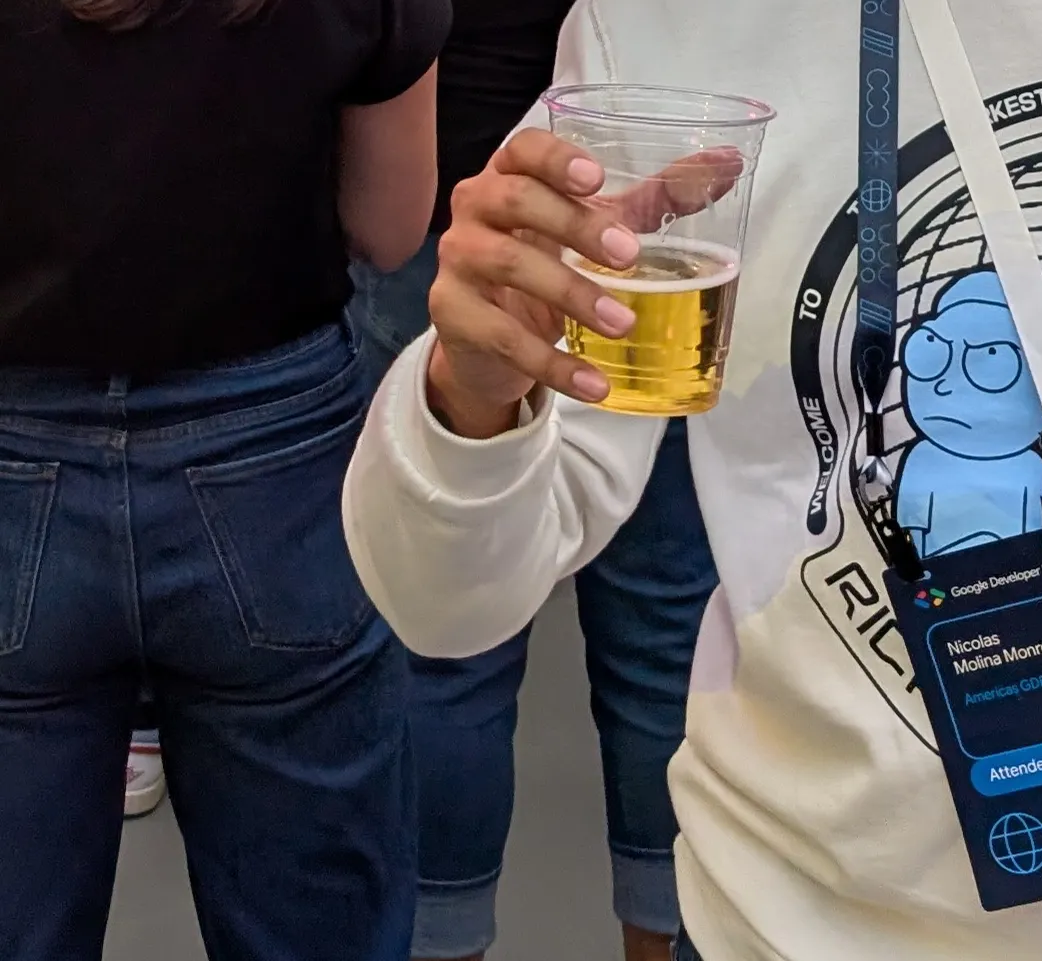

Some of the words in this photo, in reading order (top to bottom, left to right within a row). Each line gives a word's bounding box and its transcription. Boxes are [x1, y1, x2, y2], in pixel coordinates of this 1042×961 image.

[799, 287, 822, 320] TO
[802, 396, 835, 515] WELCOME
[950, 578, 989, 598] Google
[988, 566, 1042, 589] Developer
[824, 561, 917, 694] RIC
[946, 633, 1001, 657] Nicolas
[952, 651, 1003, 676] Molina
[964, 683, 1020, 707] Americas
